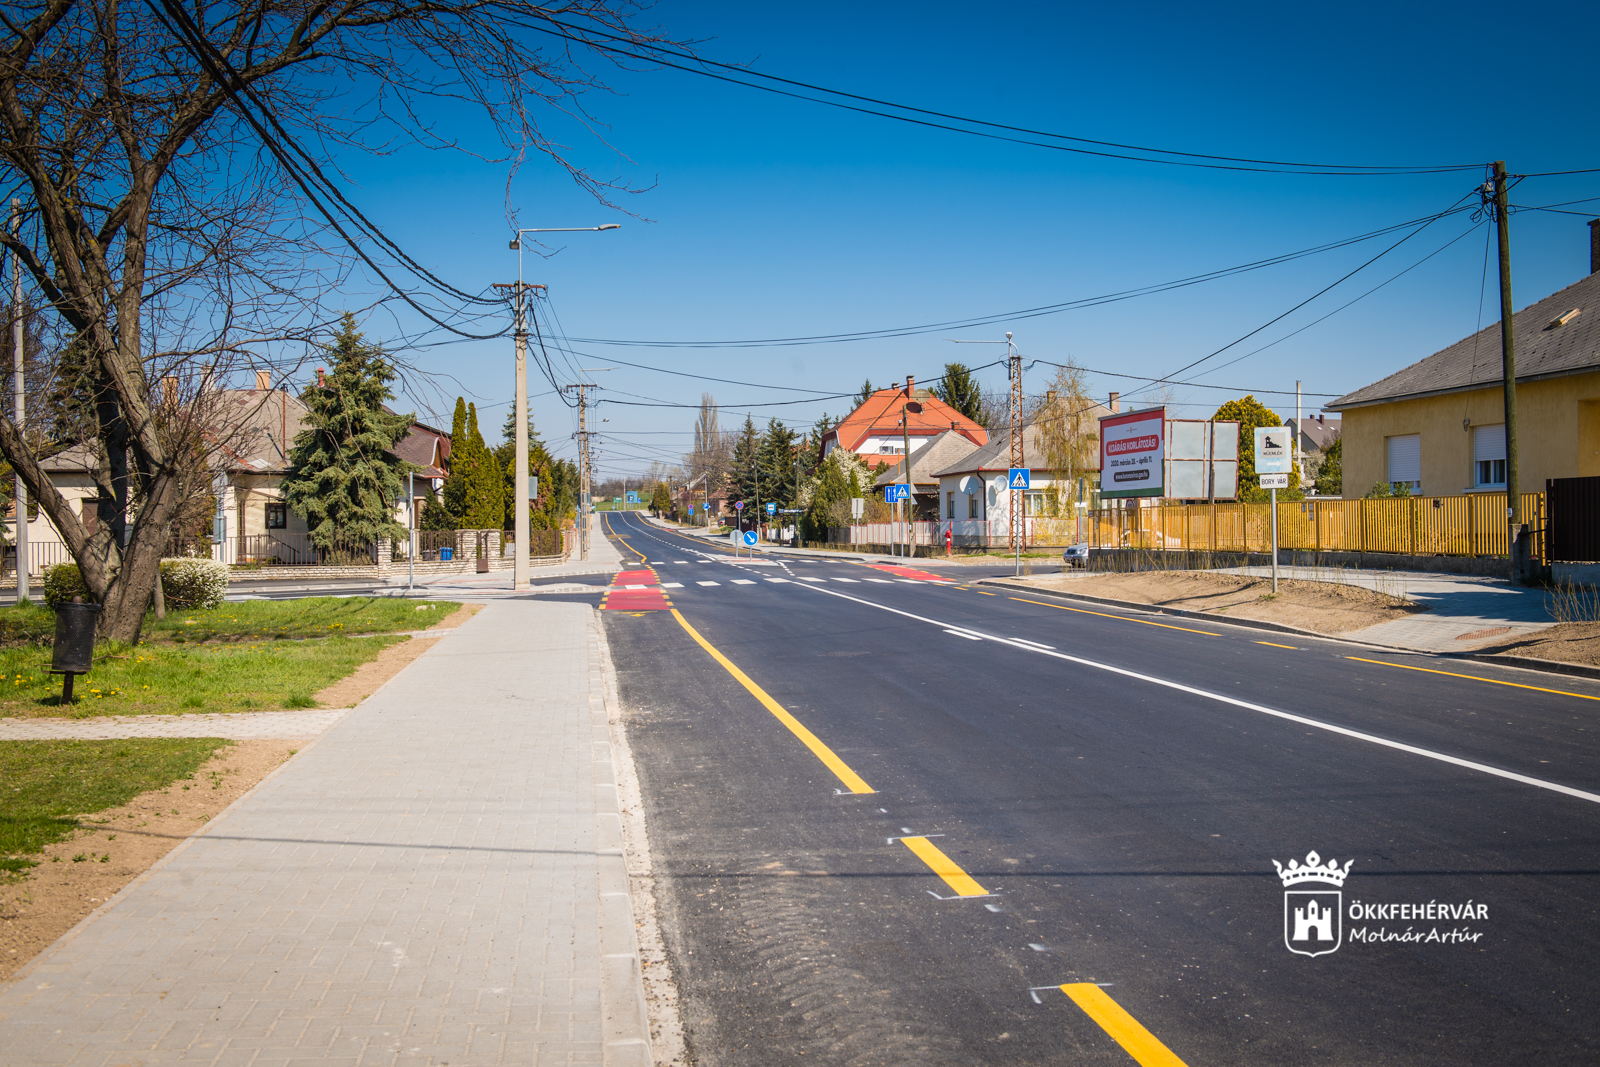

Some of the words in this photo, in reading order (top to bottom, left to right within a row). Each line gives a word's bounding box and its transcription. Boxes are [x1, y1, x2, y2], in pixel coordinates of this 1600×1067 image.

[1108, 441, 1126, 453] KIJÁRÁSI
[1127, 437, 1156, 450] KORLÁTOZÁS!
[1277, 476, 1286, 484] VÁR
